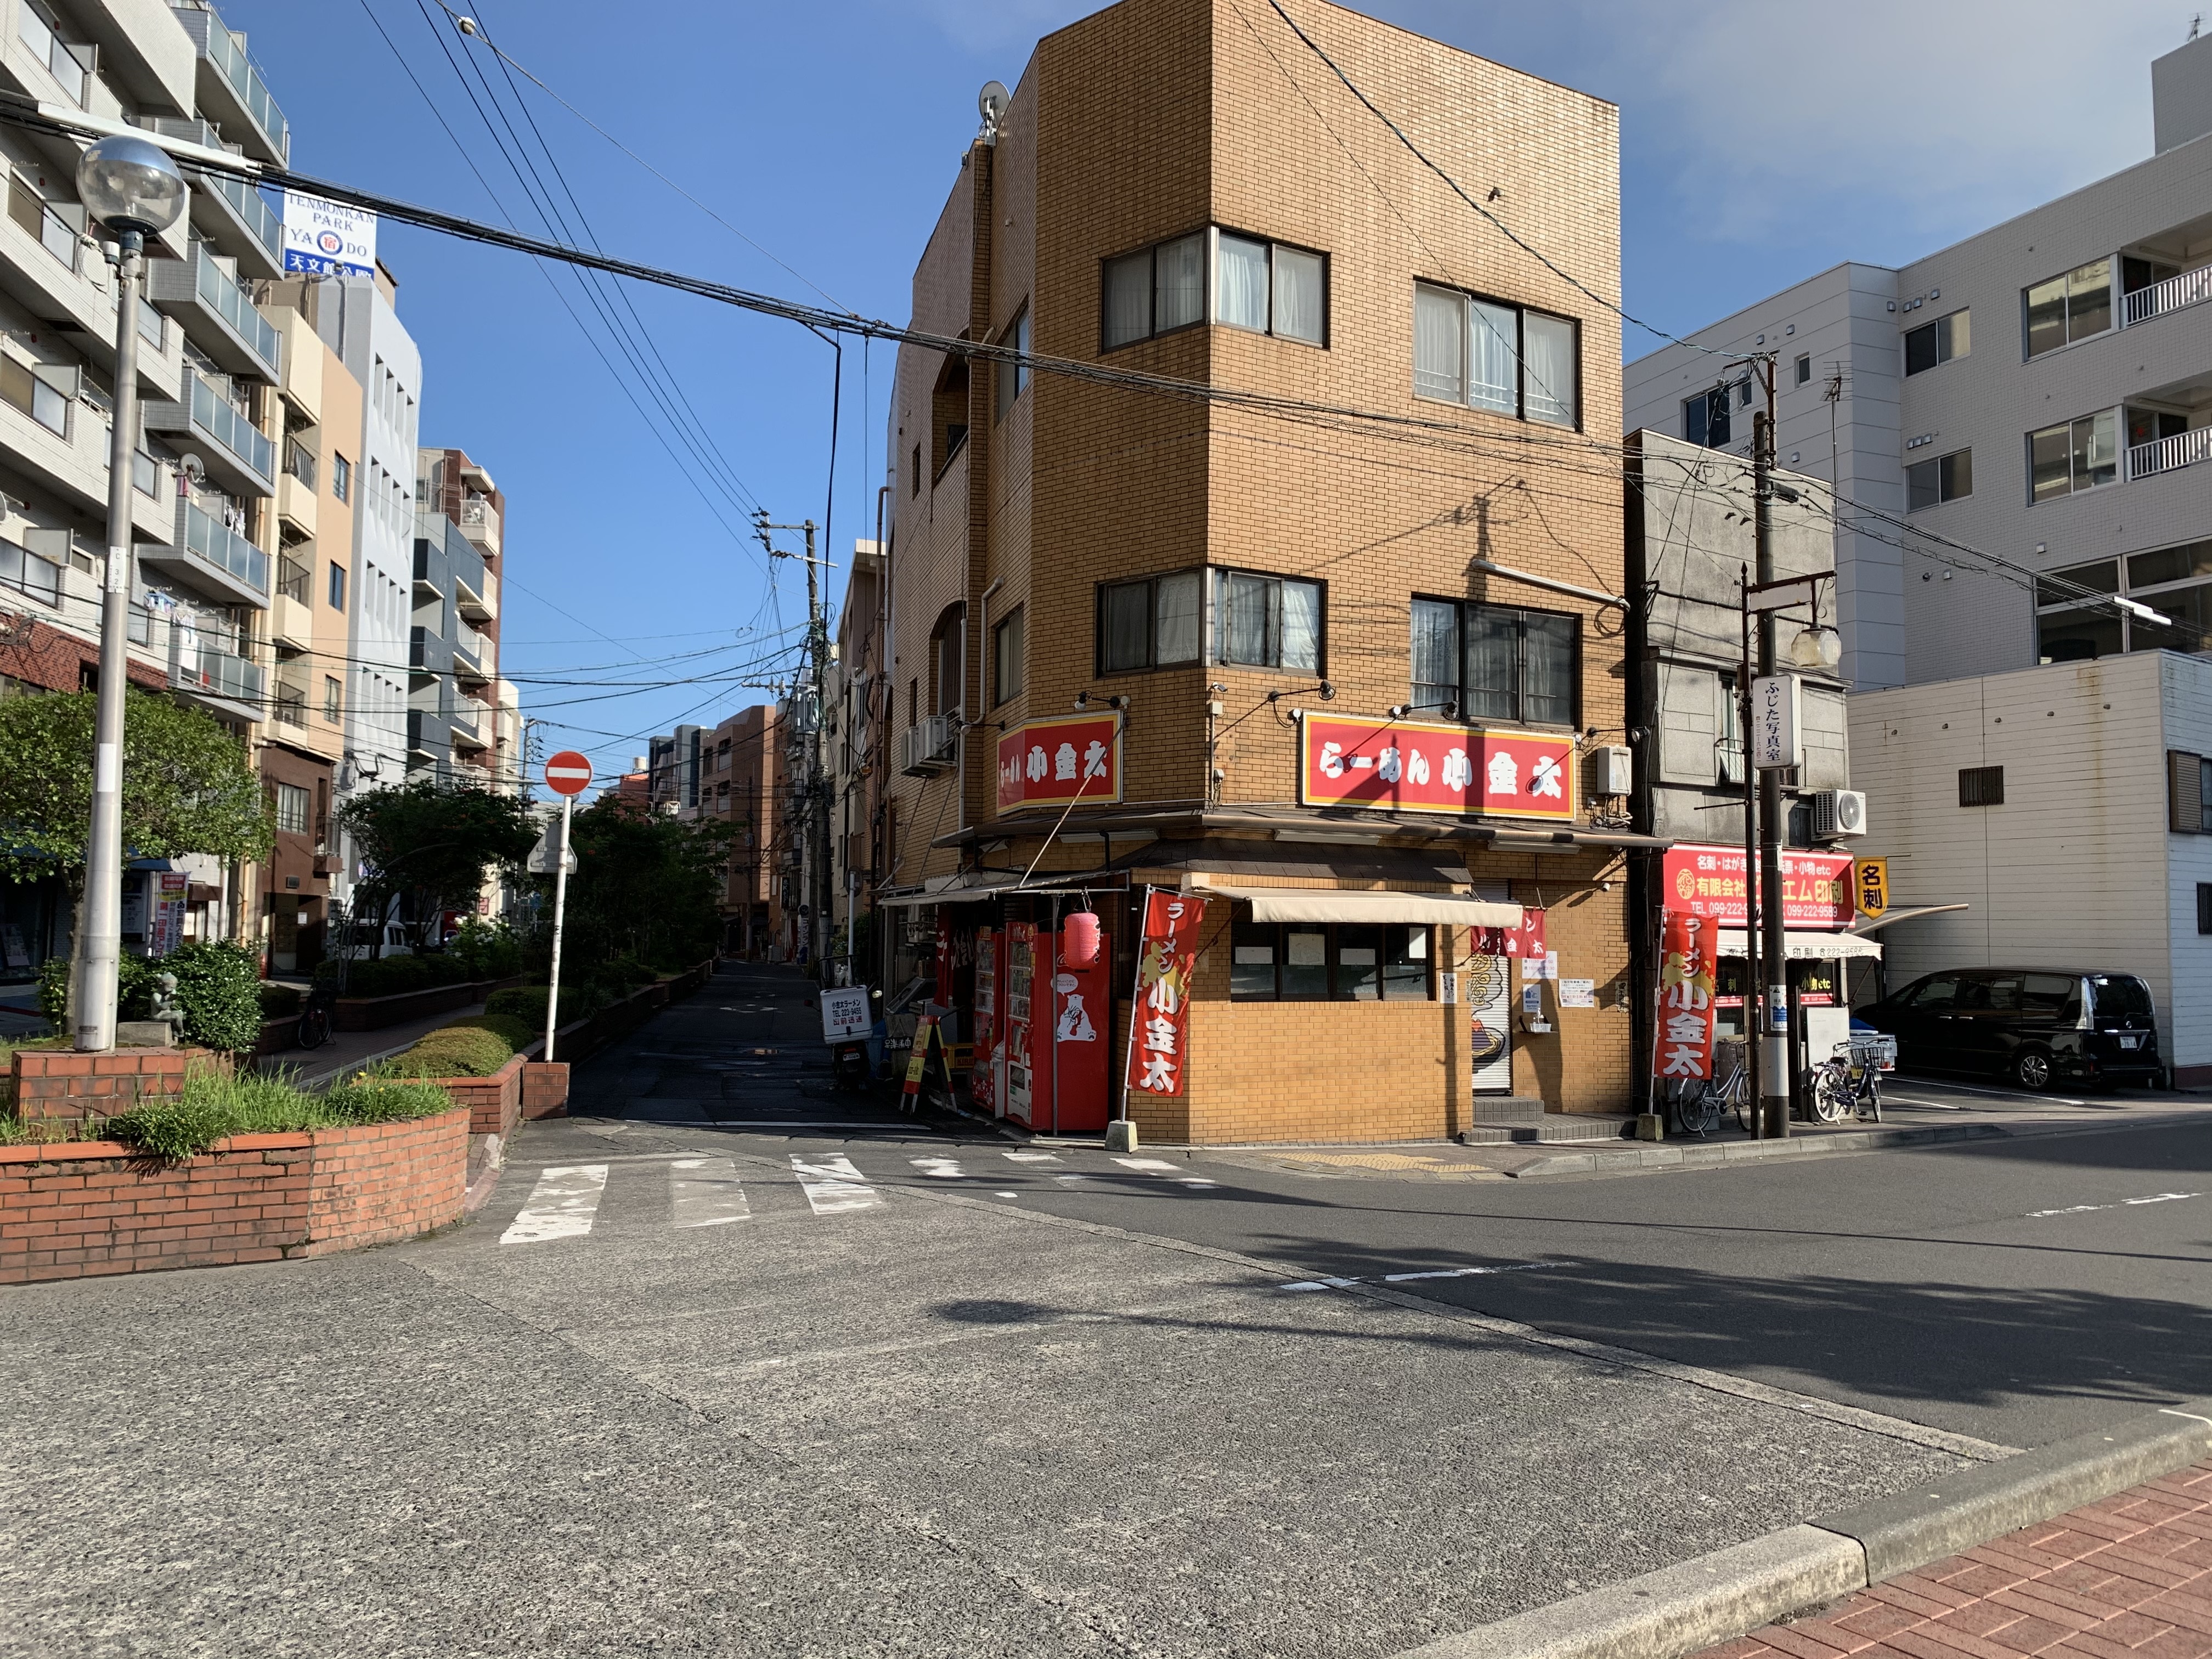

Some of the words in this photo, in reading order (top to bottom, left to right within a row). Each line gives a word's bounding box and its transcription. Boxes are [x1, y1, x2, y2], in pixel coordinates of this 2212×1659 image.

[289, 194, 374, 224] TENMONKAN
[313, 212, 354, 232] PARK
[290, 228, 313, 244] YA
[347, 242, 367, 257] DO
[1765, 681, 1781, 761] ふじた写真室
[1861, 864, 1883, 910] 名刺
[1691, 901, 1707, 914] TEL
[1787, 905, 1838, 918] 099-222-9589
